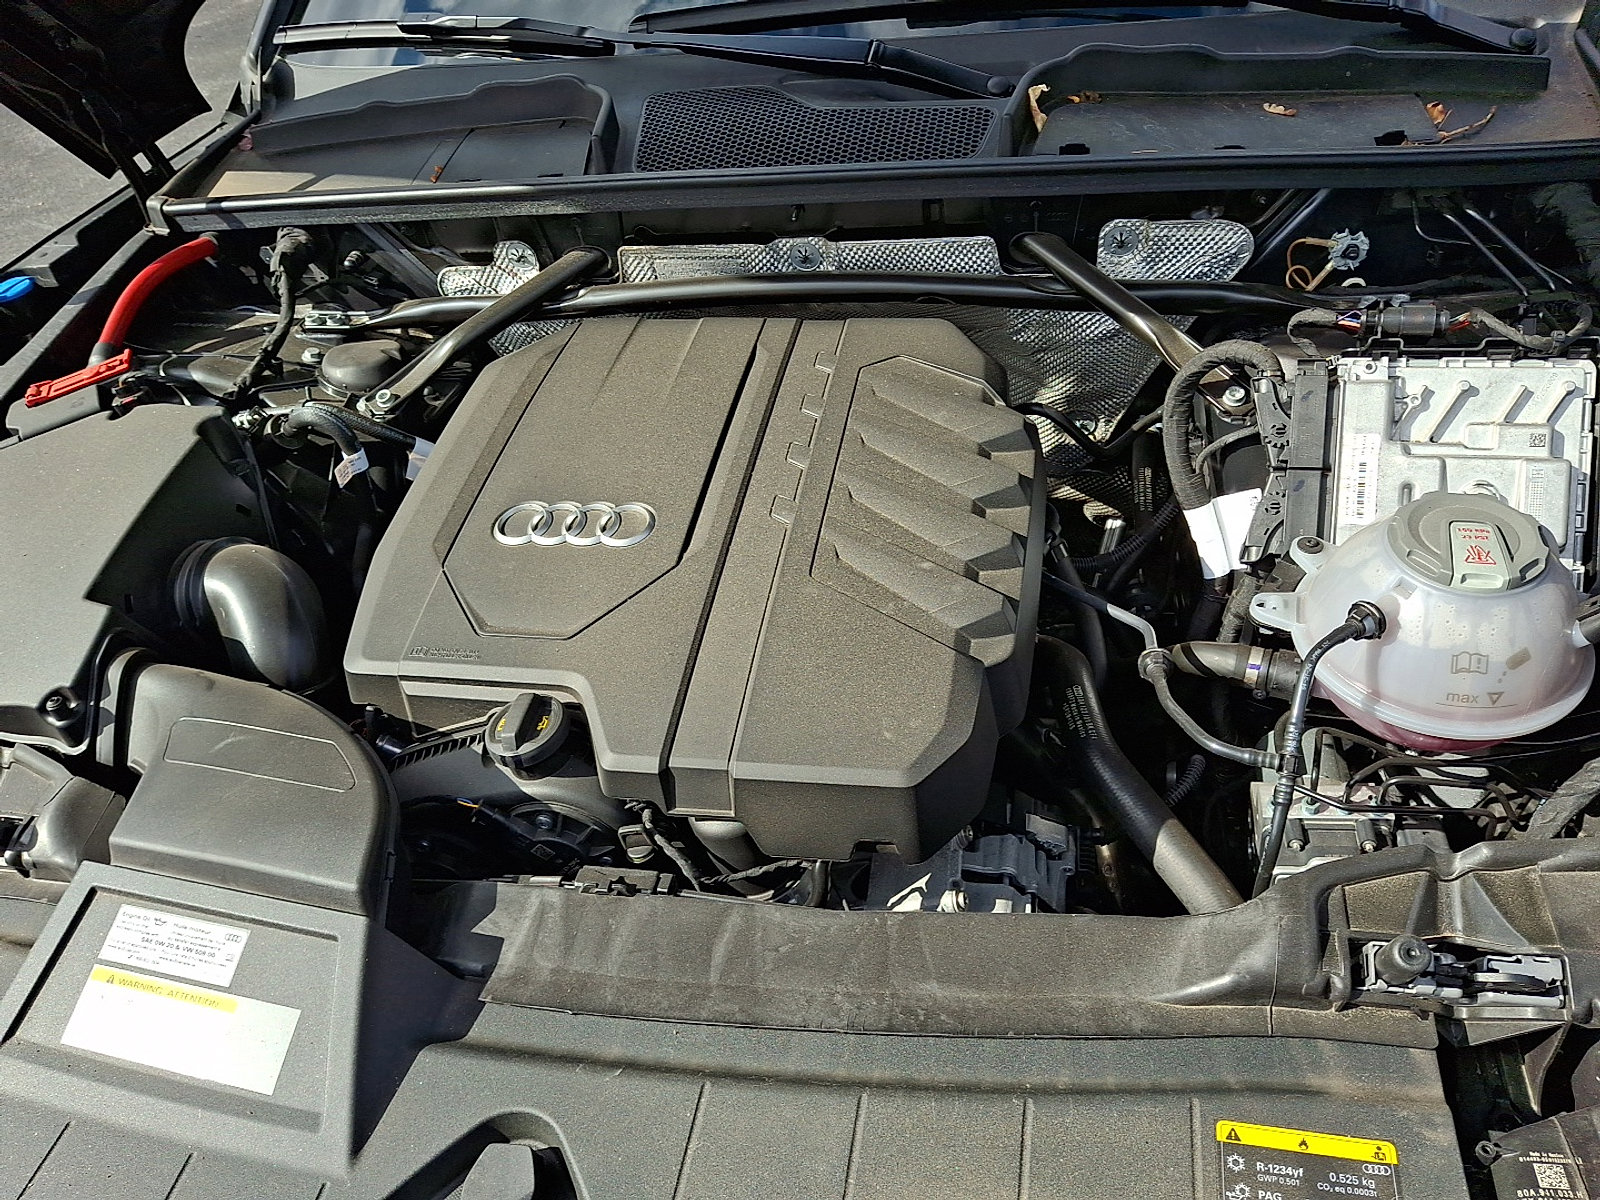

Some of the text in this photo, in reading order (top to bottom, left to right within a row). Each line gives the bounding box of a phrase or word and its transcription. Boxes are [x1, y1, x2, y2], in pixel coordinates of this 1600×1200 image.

[1446, 693, 1479, 704] max
[141, 936, 153, 944] SAE
[1256, 1162, 1304, 1178] R-1234yf
[1257, 1174, 1300, 1187] GWP 0.501
[1329, 1172, 1375, 1189] 0.525 kg
[1258, 1190, 1282, 1200] PAG
